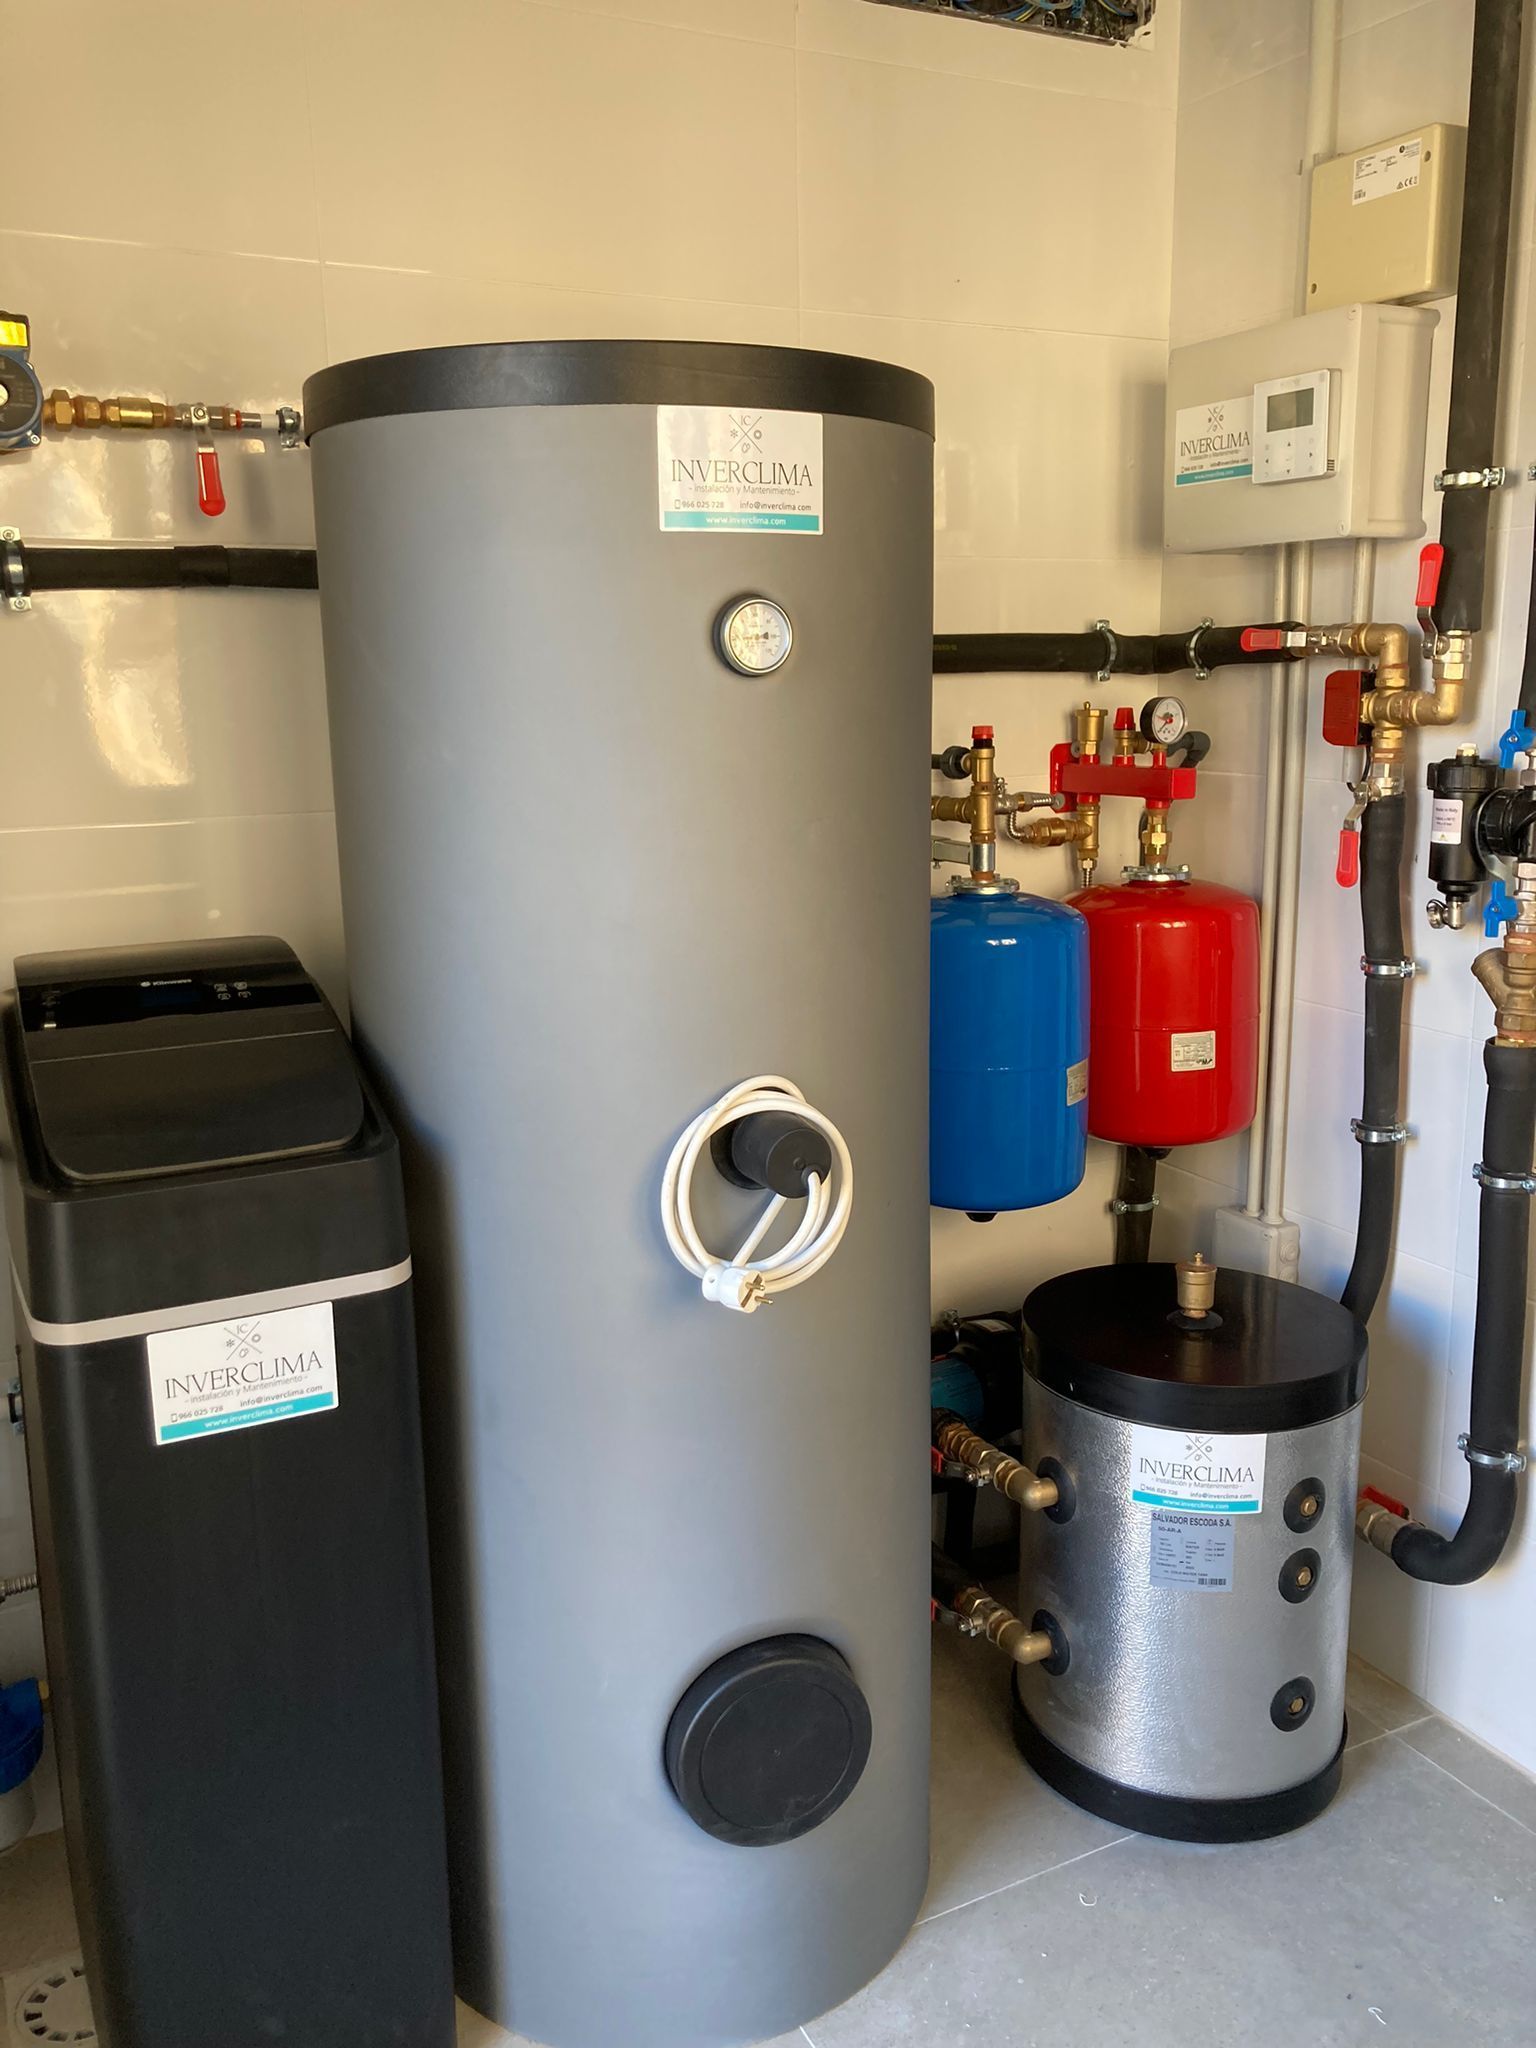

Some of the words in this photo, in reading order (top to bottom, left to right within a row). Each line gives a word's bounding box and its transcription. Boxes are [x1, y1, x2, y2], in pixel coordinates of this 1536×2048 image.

[1180, 431, 1250, 456] INVERCLIMA
[671, 459, 813, 486] INVERCLIMA
[694, 485, 735, 494] Instalación
[743, 485, 796, 496] Mantenimiento
[682, 500, 695, 509] 966
[696, 500, 710, 509] 025
[711, 501, 724, 509] 728
[706, 516, 787, 526] www.inverclima.com
[165, 1350, 323, 1399] INVERCLIMA
[190, 1389, 234, 1404] Instalación
[242, 1375, 303, 1395] Mantenimiento
[178, 1409, 193, 1421] 966
[194, 1407, 209, 1418] 025
[210, 1405, 224, 1415] 728
[204, 1403, 294, 1428] www.inverclima.com
[1140, 1457, 1255, 1483] INVERCLIMA
[1193, 1481, 1239, 1489] Mantenimiento
[1152, 1512, 1189, 1525] SALVADOR
[1189, 1517, 1218, 1527] ESCODA
[1219, 1518, 1232, 1527] S.A.
